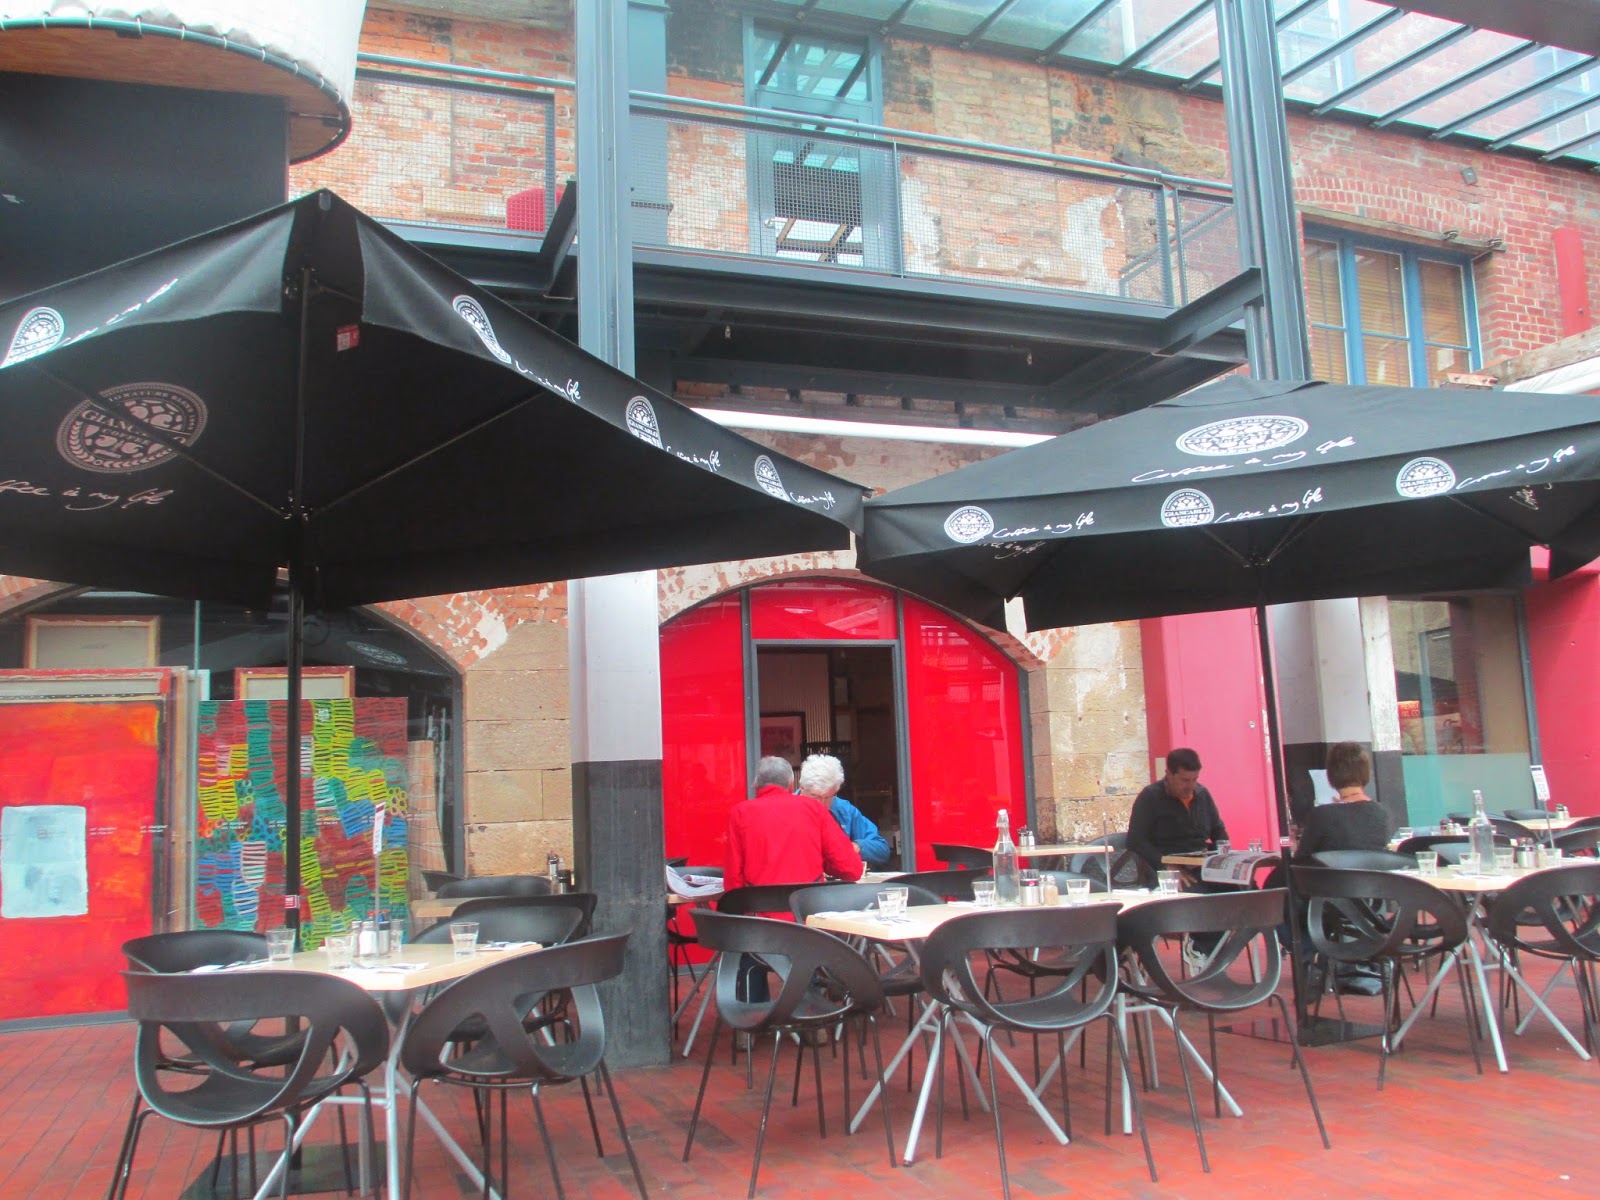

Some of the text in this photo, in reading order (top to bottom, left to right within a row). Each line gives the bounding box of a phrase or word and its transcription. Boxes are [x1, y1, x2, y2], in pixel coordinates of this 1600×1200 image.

[1131, 464, 1234, 483] Coffee
[1302, 487, 1324, 509] life
[1075, 511, 1095, 530] life
[1164, 507, 1210, 517] GIANCARLO
